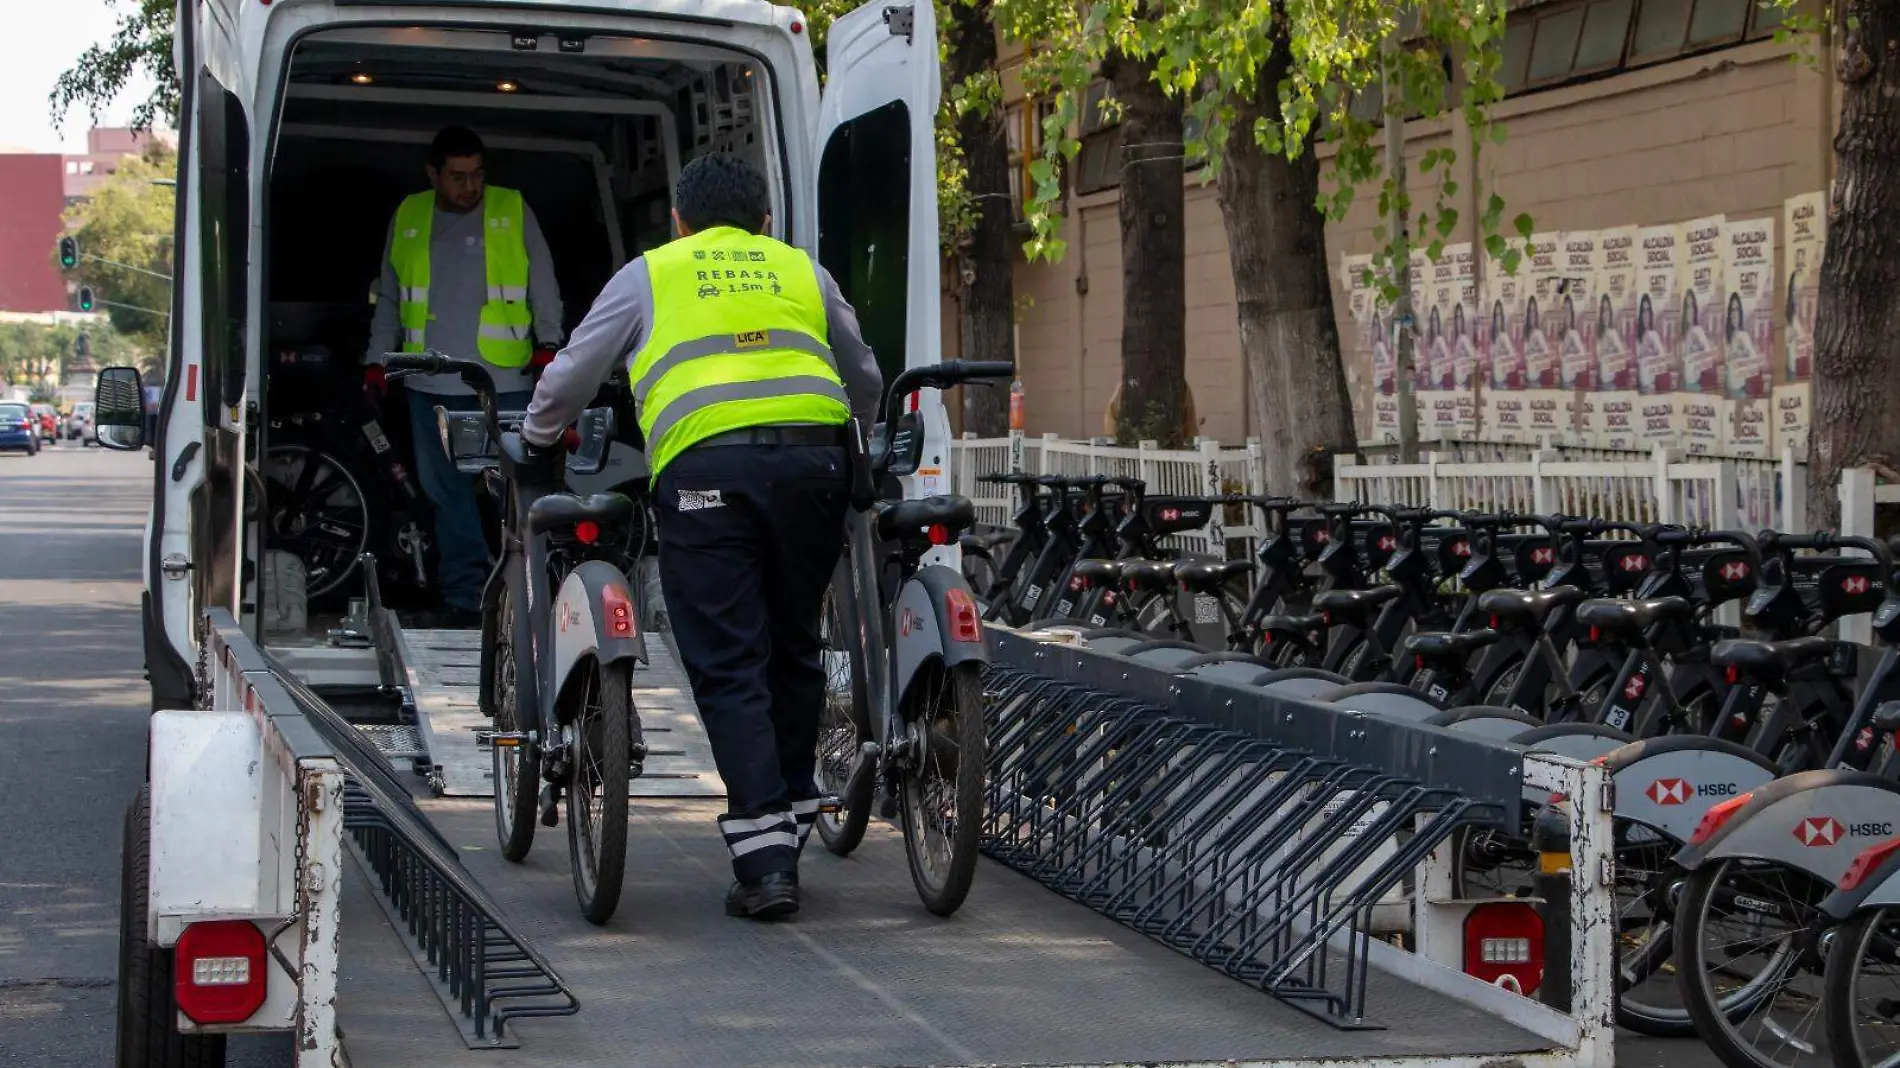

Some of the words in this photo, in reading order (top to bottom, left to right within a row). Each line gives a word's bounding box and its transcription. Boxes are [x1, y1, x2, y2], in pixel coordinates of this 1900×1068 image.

[1607, 250, 1628, 262] SOCIAL
[1647, 249, 1670, 262] SOCIAL
[1736, 245, 1762, 259] SOCIAL
[696, 269, 778, 281] REBASA
[1740, 271, 1758, 284] CATY
[728, 283, 763, 293] 1.5m
[737, 330, 764, 343] LICA
[1607, 413, 1628, 425] SOCIAL
[1697, 782, 1738, 797] HSBC
[1850, 822, 1893, 837] HSBC
